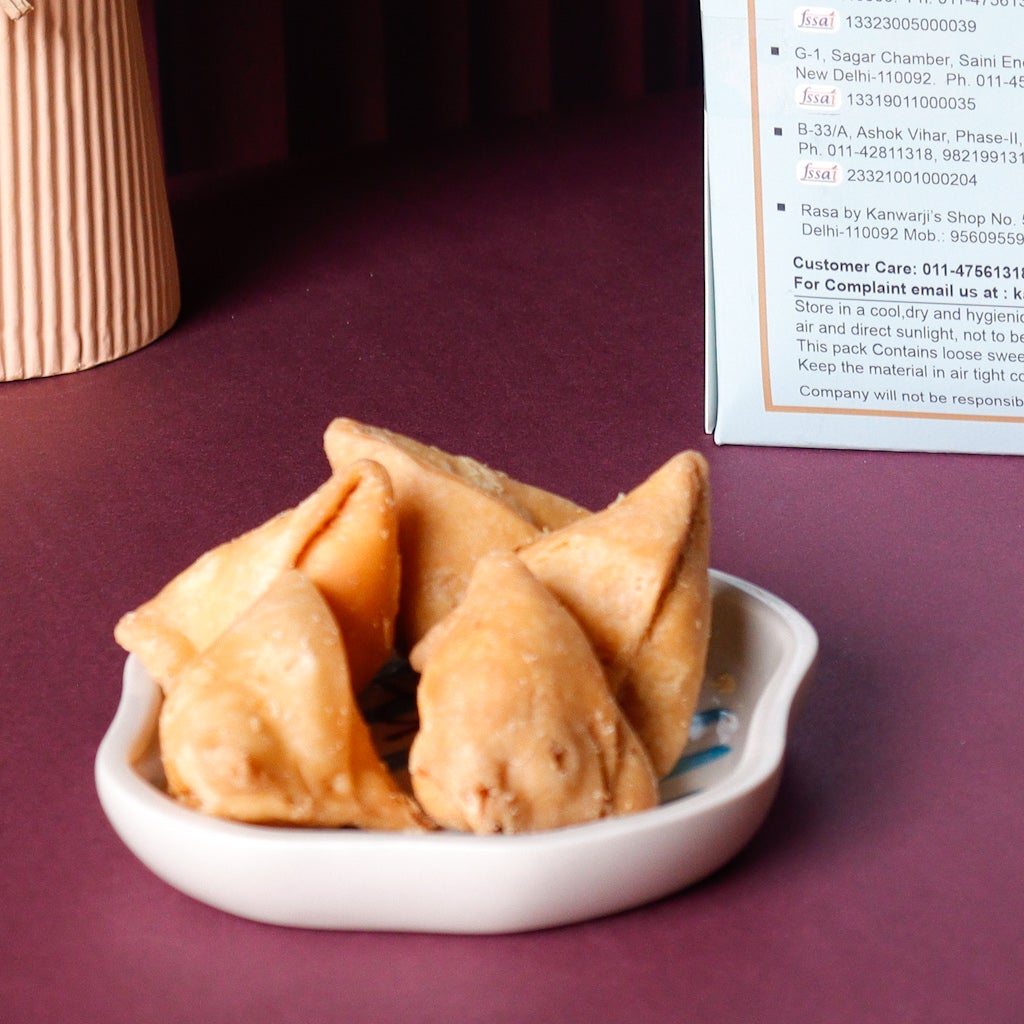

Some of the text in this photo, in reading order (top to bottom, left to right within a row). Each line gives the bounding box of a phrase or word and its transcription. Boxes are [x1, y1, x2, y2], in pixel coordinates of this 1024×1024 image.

[845, 15, 977, 33] 13323005000039
[794, 46, 826, 63] G-1,
[831, 48, 876, 66] Sagar
[880, 50, 954, 69] Chamber,
[958, 53, 996, 68] Saini
[846, 92, 976, 111] 13319011000035
[792, 255, 870, 273] Customer
[874, 260, 917, 276] Care:
[794, 275, 820, 291] For
[824, 278, 907, 297] Complaint
[910, 283, 954, 297] email
[959, 287, 978, 298] us
[983, 286, 998, 299] at
[794, 298, 834, 315] Store
[838, 301, 851, 316] in
[856, 305, 866, 317] a
[933, 306, 961, 321] and
[799, 384, 870, 403] Company
[873, 388, 897, 402] will
[901, 391, 925, 403] not
[928, 391, 947, 404] be
